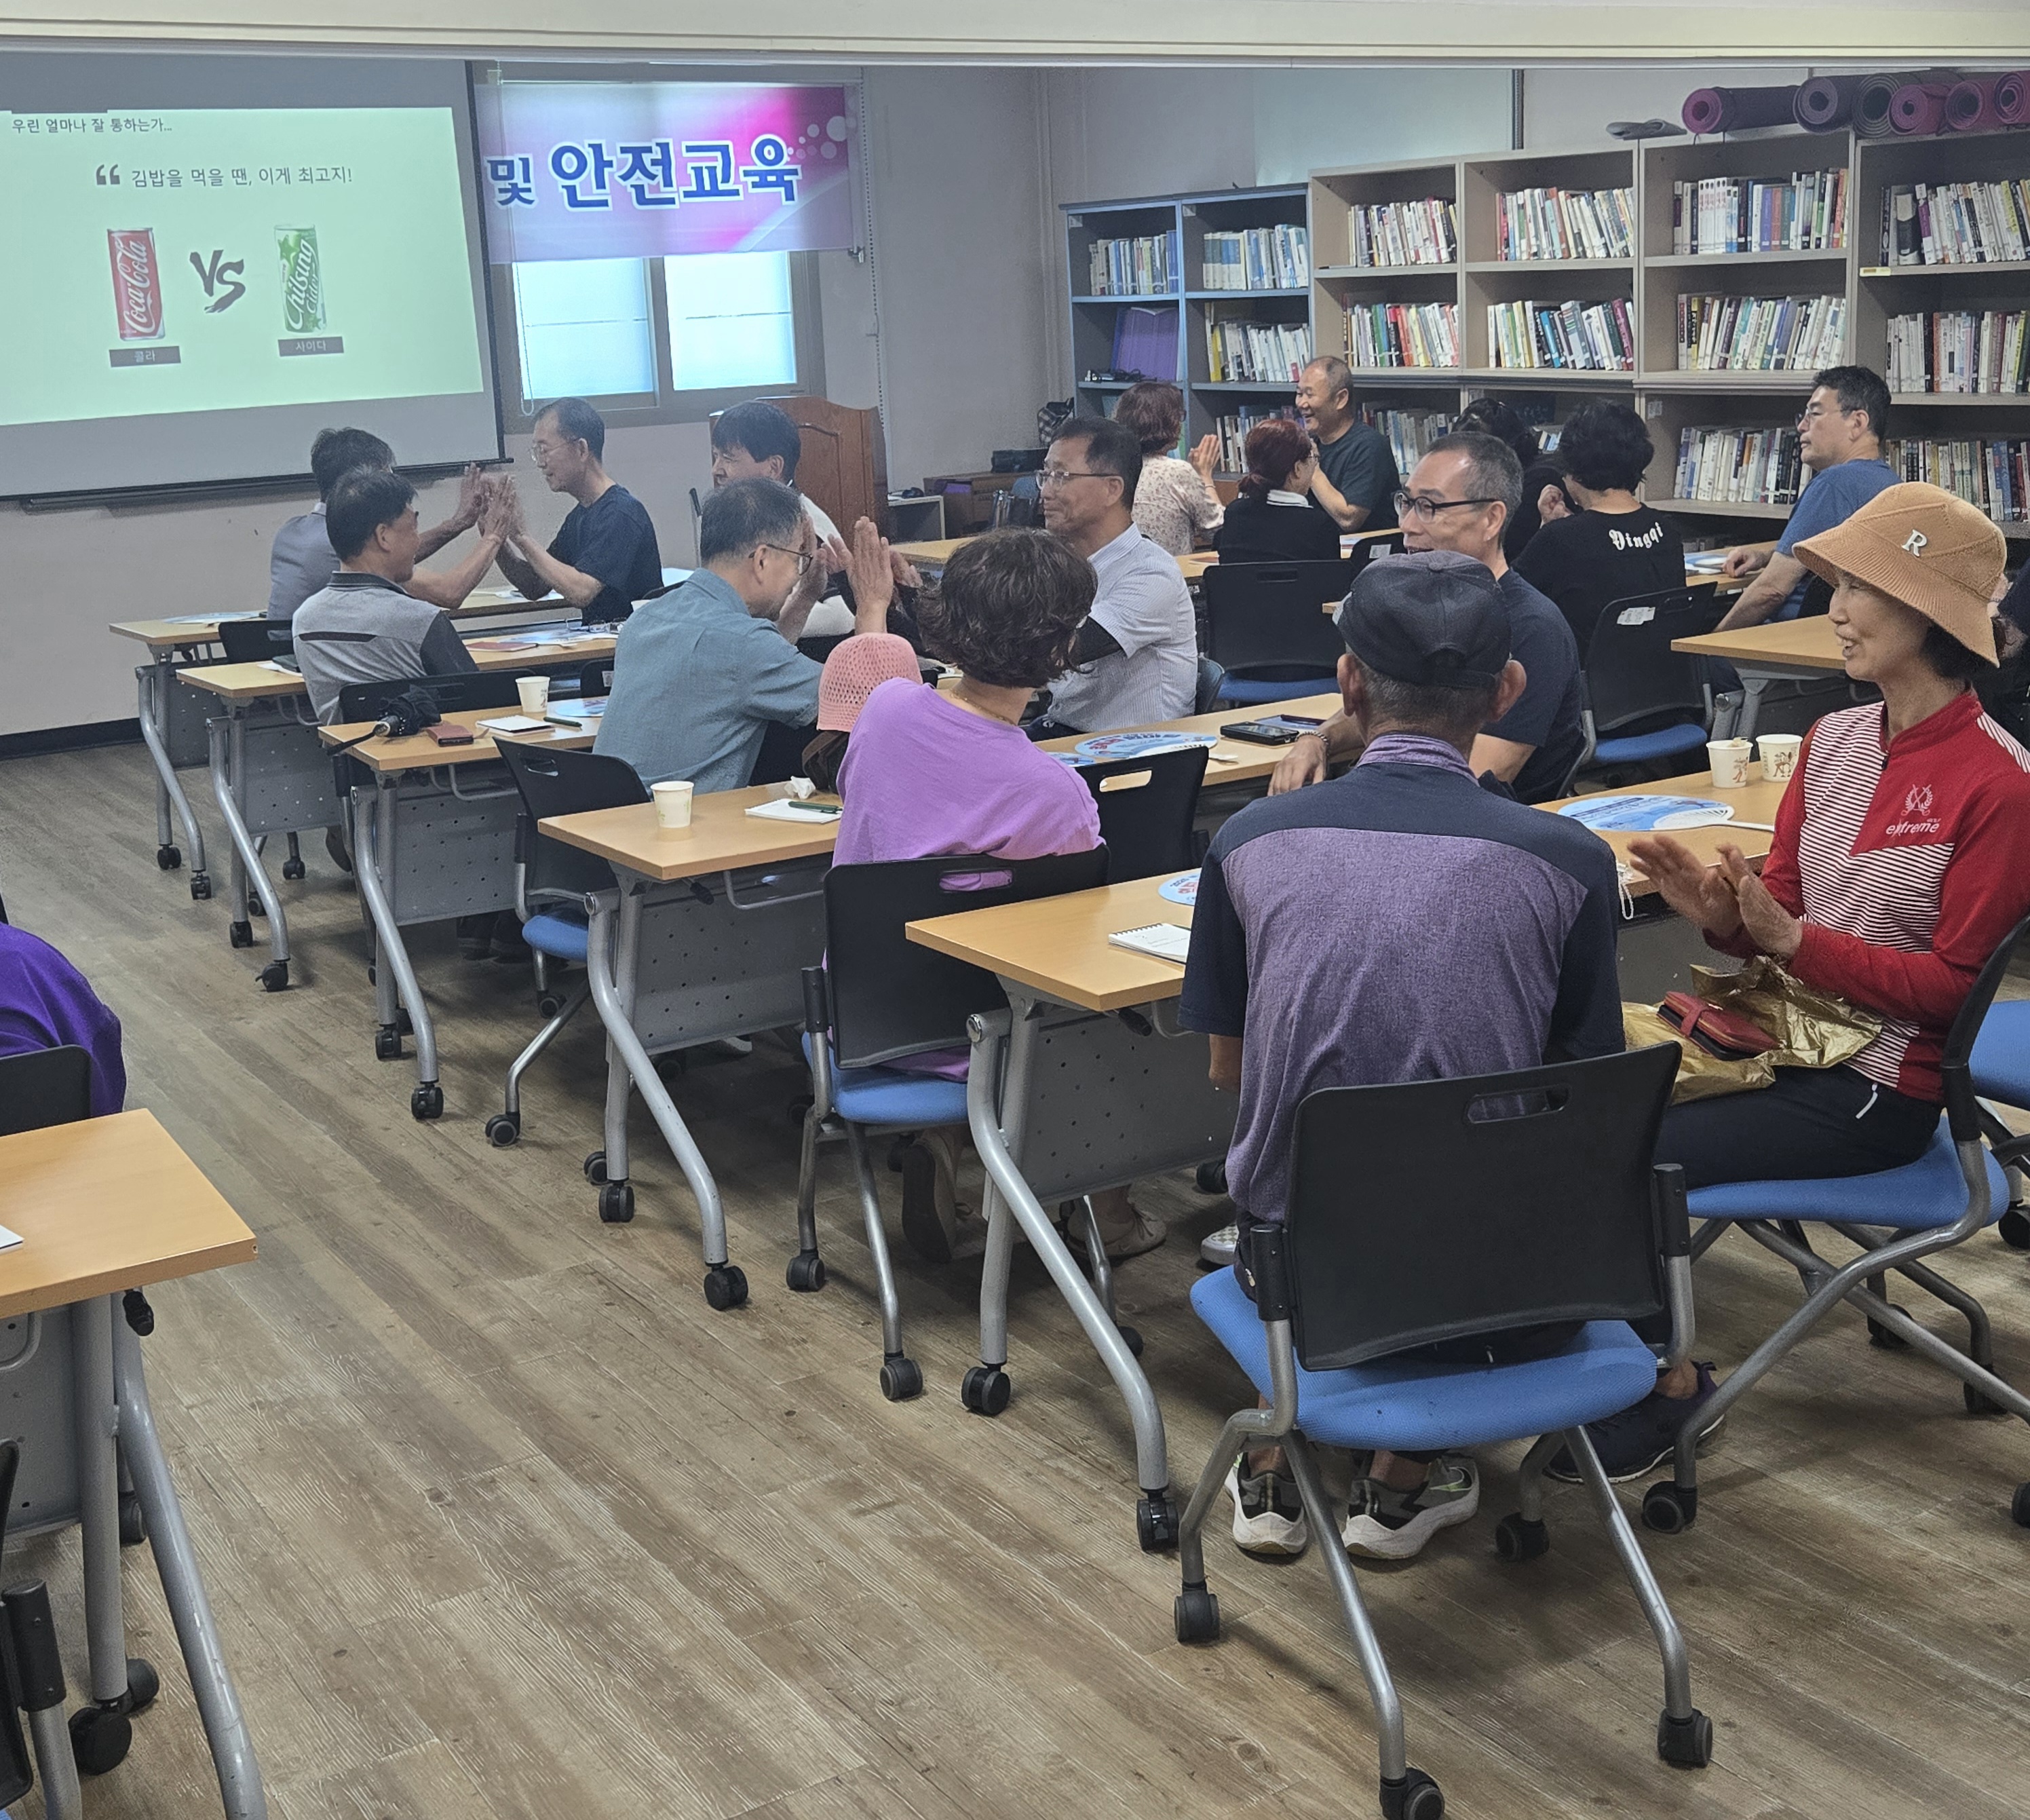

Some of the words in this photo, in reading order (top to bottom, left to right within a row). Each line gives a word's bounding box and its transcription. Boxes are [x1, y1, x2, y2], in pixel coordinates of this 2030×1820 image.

[12, 118, 40, 134] 우린
[45, 118, 86, 133] 얼마나
[91, 117, 104, 132] 잘
[132, 168, 183, 188] 김밥을
[191, 168, 225, 187] 먹을
[231, 168, 252, 187] 땐,
[258, 167, 292, 185] 이게
[298, 166, 353, 185] 최고지!
[485, 155, 536, 206] 및
[549, 136, 801, 209] 안전교육
[189, 249, 246, 314] VS
[285, 239, 320, 330] Chilsung
[295, 341, 326, 352] 사이다
[1901, 529, 1928, 557] R
[1885, 820, 1940, 837] extreme
